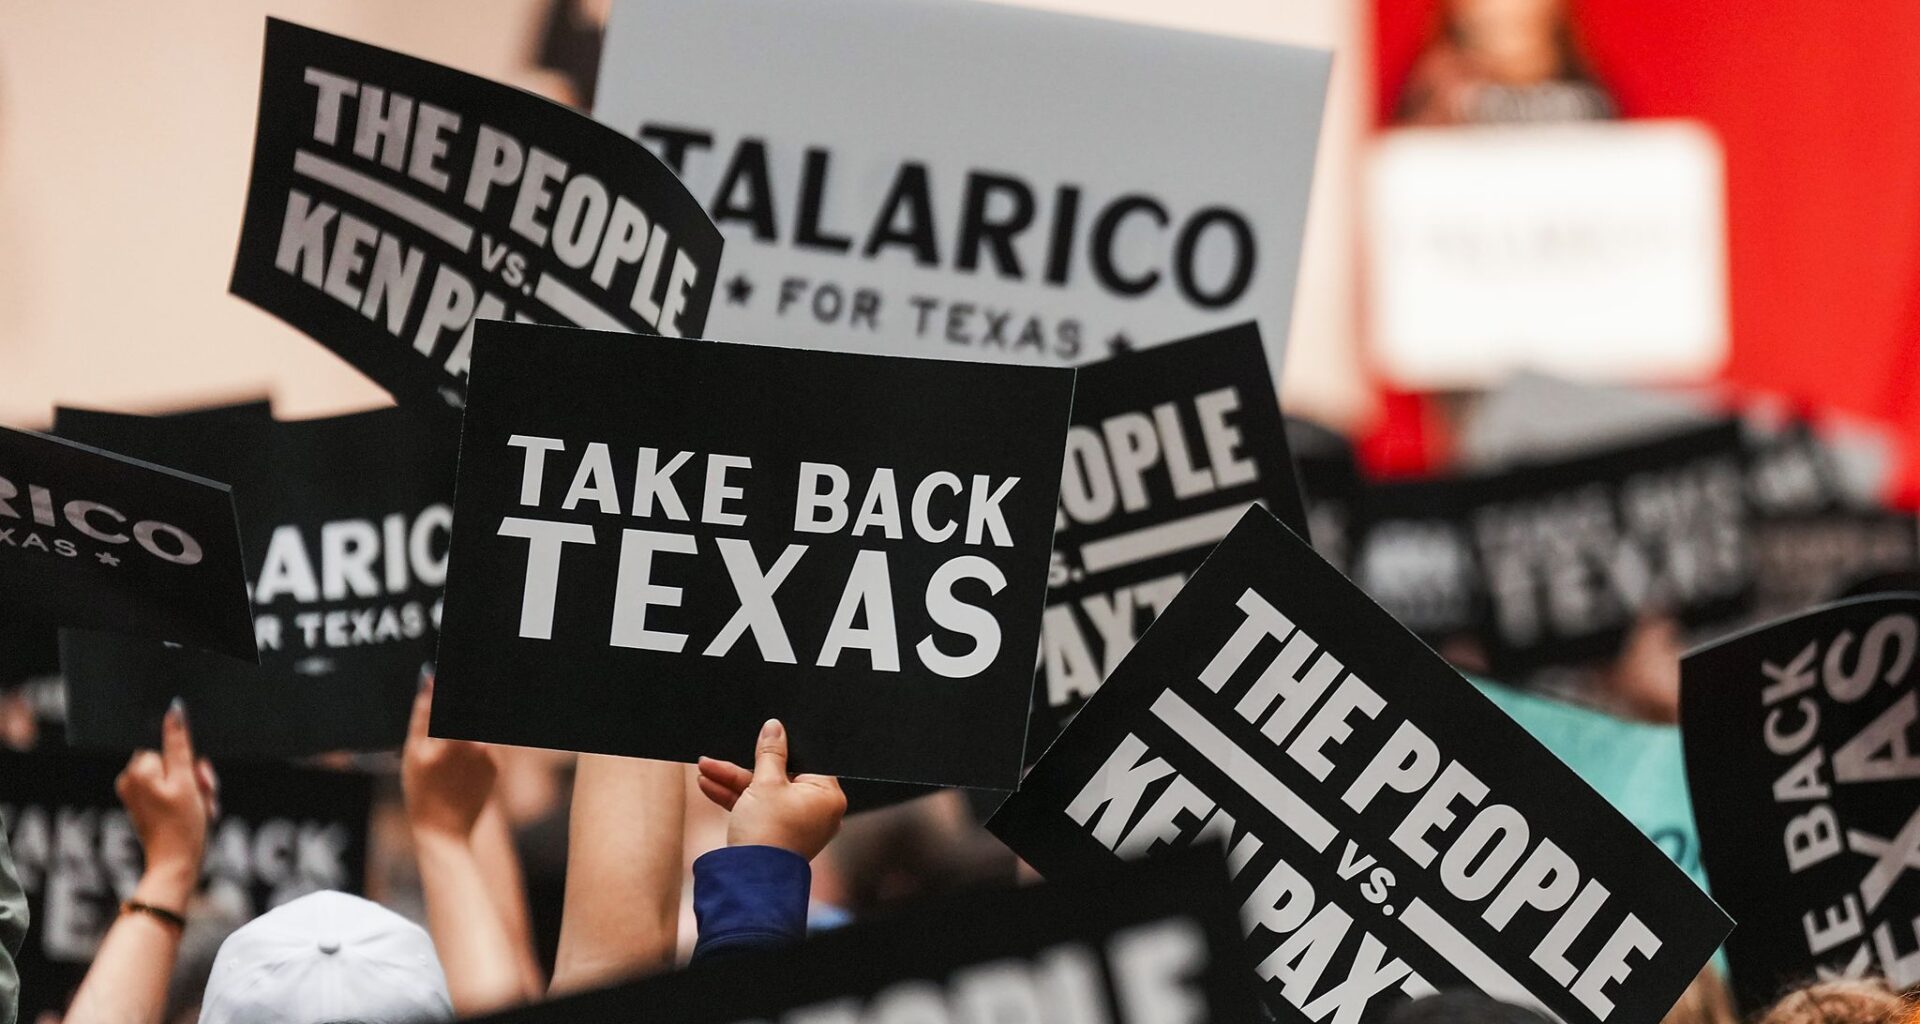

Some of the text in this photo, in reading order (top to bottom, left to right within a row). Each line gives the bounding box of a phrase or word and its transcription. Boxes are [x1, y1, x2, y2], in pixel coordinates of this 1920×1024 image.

[275, 190, 425, 337] KEN
[304, 67, 698, 339] THE PEOPLE
[641, 122, 1258, 312] TALARICO
[778, 277, 1082, 358] FOR TEXAS
[507, 434, 1021, 548] TAKE BACK
[1054, 386, 1258, 534] OPLE
[247, 503, 454, 604] ARIC
[294, 602, 424, 648] TEXAS
[496, 516, 1008, 679] TEXAS
[1197, 587, 1388, 783] THE
[1340, 718, 1663, 1022] PEOPLE
[1762, 639, 1843, 873] BACK
